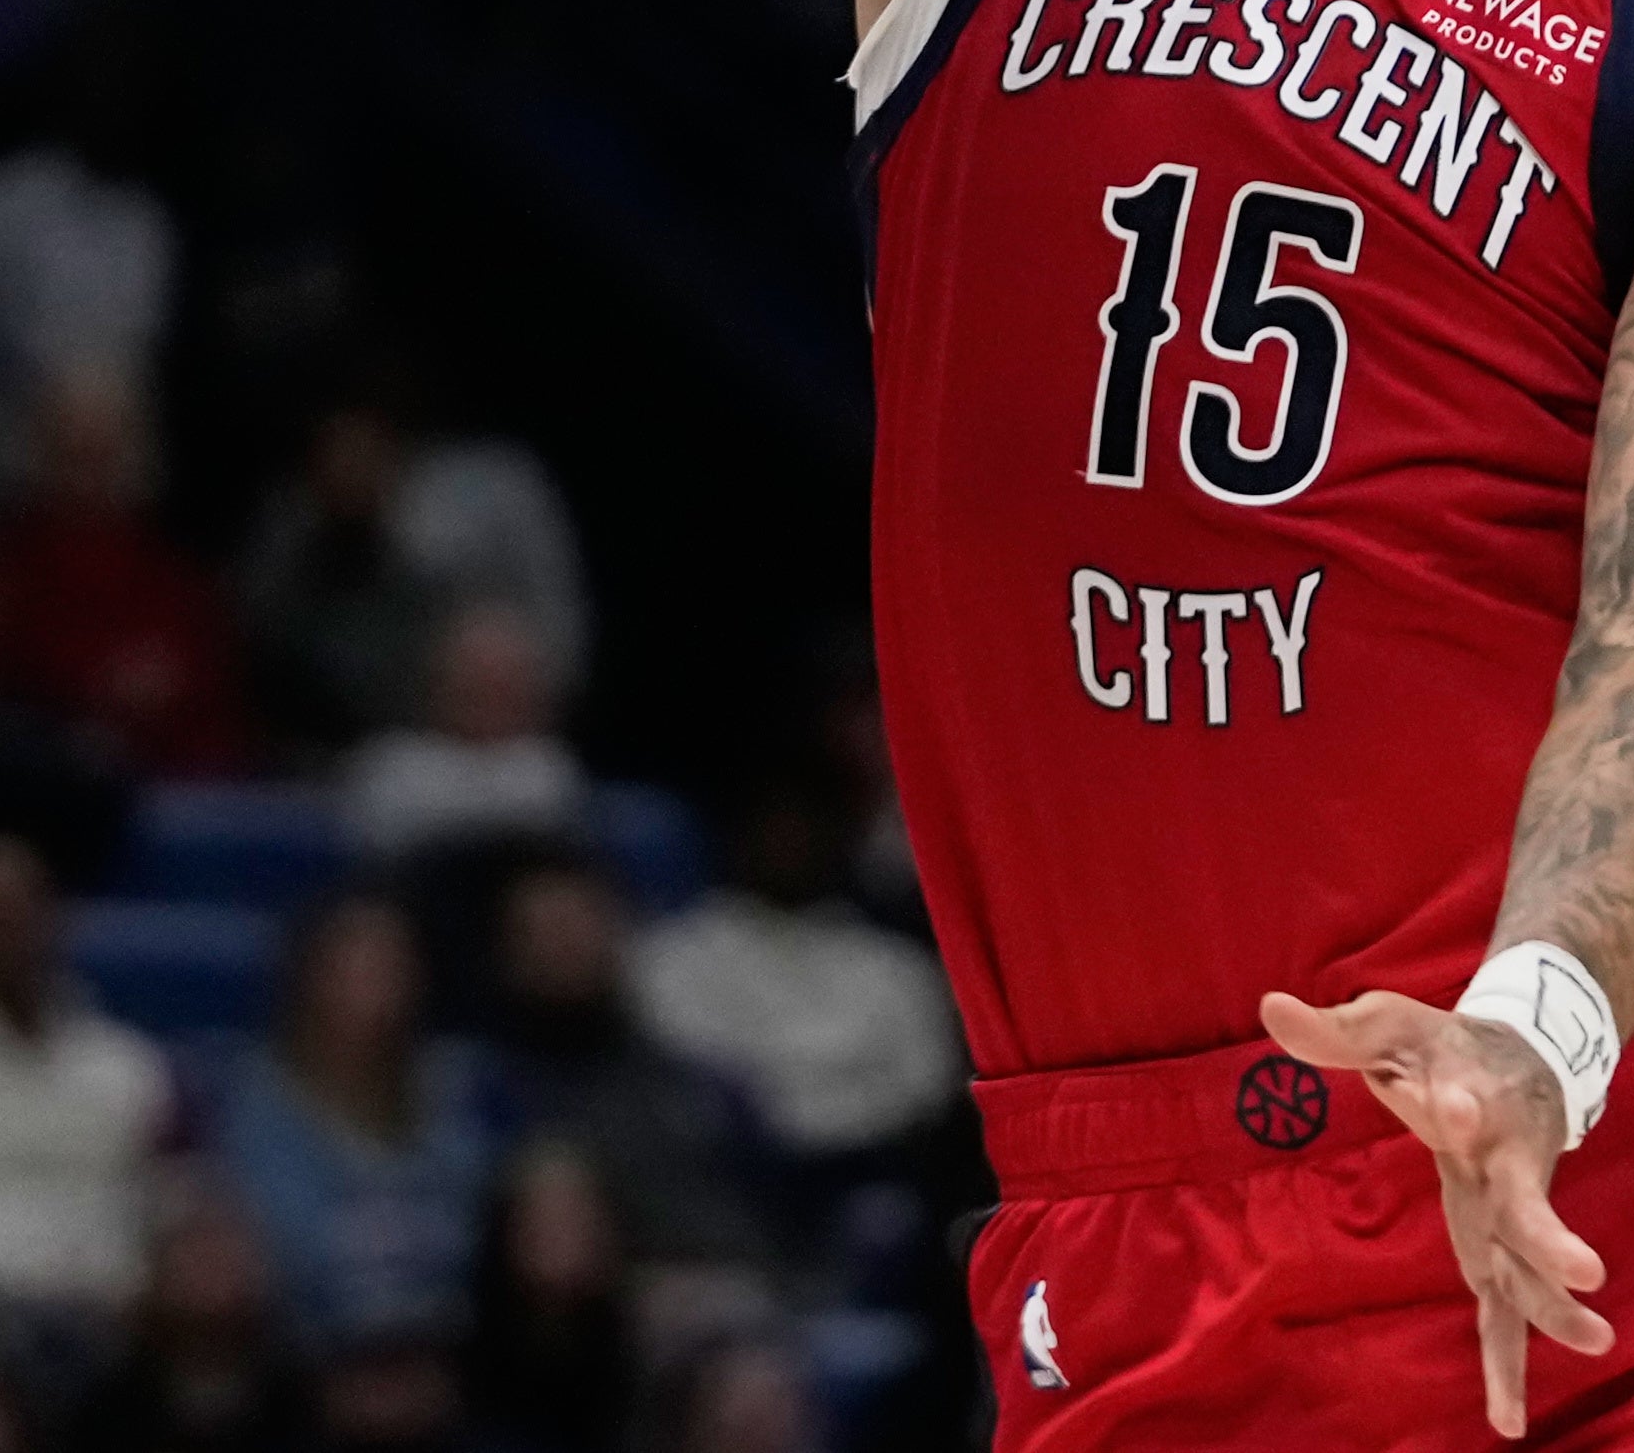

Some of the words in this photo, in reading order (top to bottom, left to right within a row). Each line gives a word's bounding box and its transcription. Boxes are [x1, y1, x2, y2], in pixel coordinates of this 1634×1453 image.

[1421, 9, 1567, 85] PRODUCTS
[1085, 162, 1365, 506] 15
[1070, 567, 1322, 724] CITY
